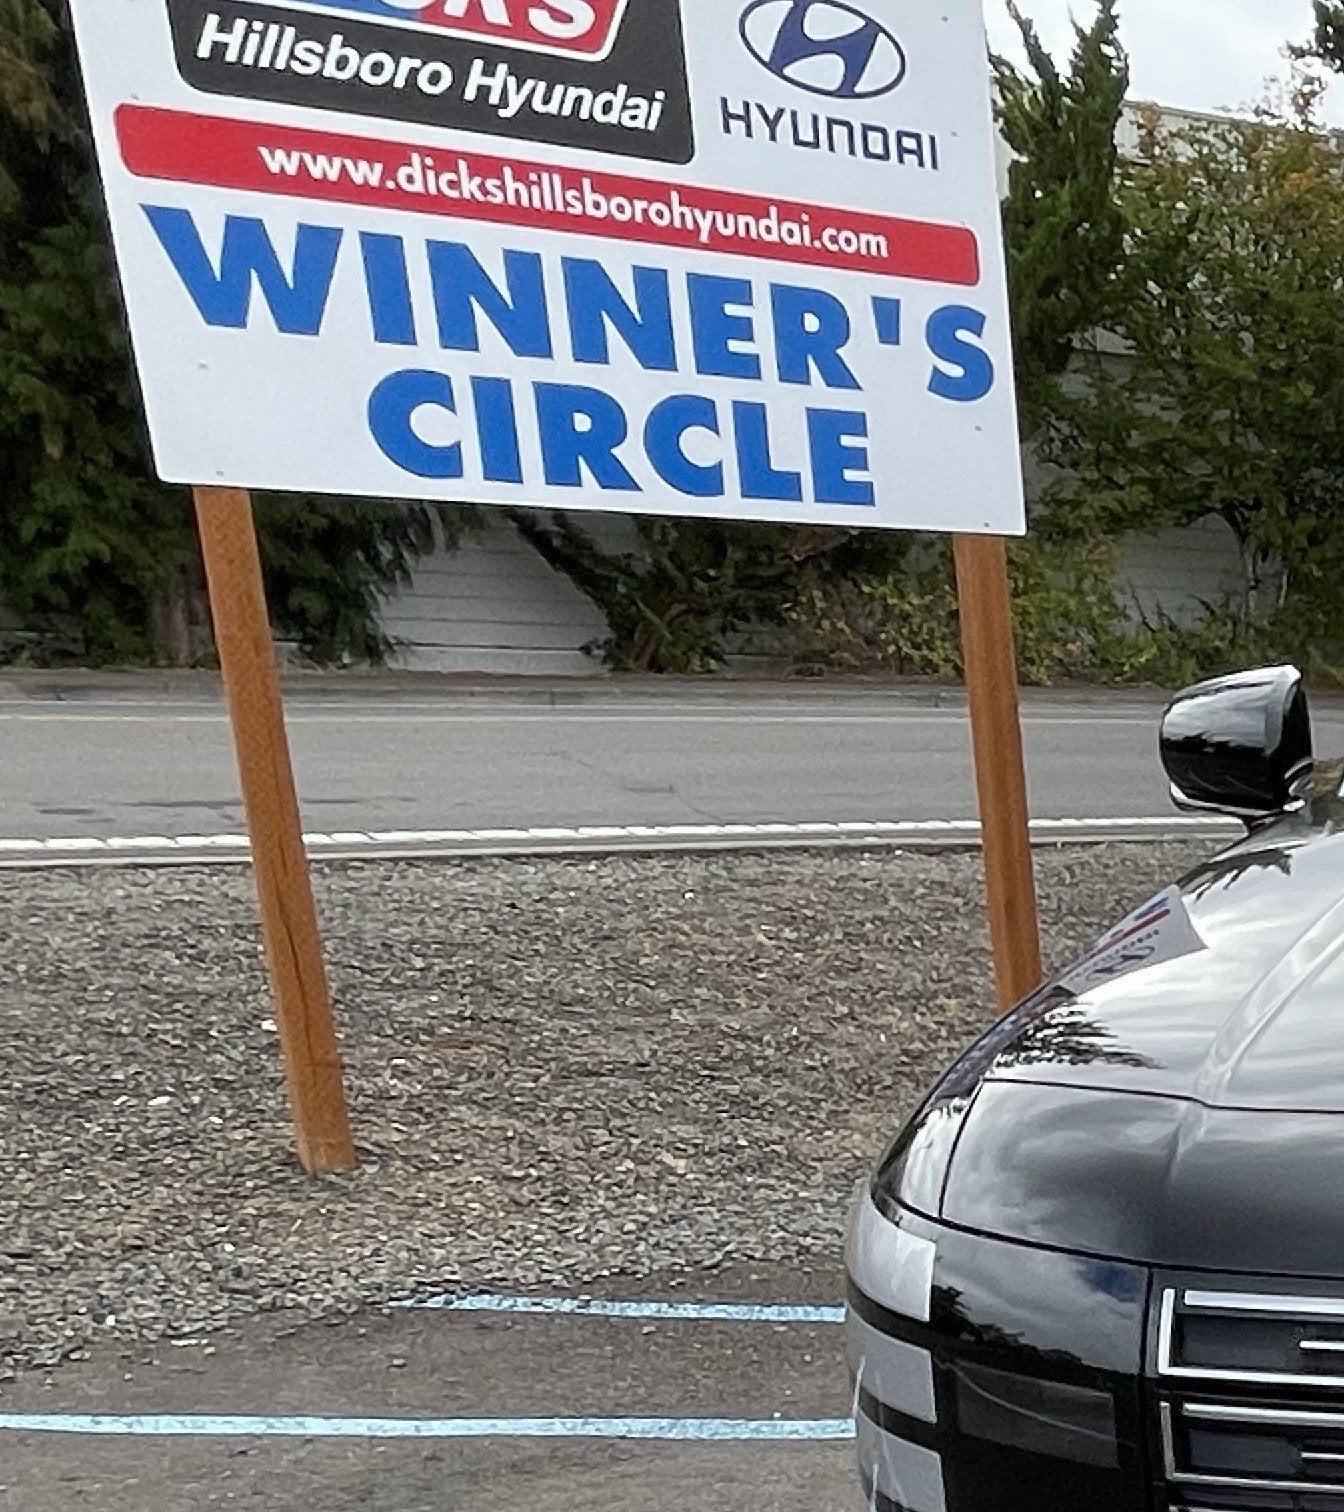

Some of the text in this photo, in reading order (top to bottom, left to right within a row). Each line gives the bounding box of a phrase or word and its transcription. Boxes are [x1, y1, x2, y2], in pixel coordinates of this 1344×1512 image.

[196, 14, 454, 96] Hillsboro
[463, 58, 667, 132] Hyundai
[720, 96, 940, 170] HYUNDAI
[258, 144, 889, 260] www.dickshillsborohyundai.com
[139, 204, 995, 402] WINNER'S
[367, 369, 876, 508] CIRCLE
